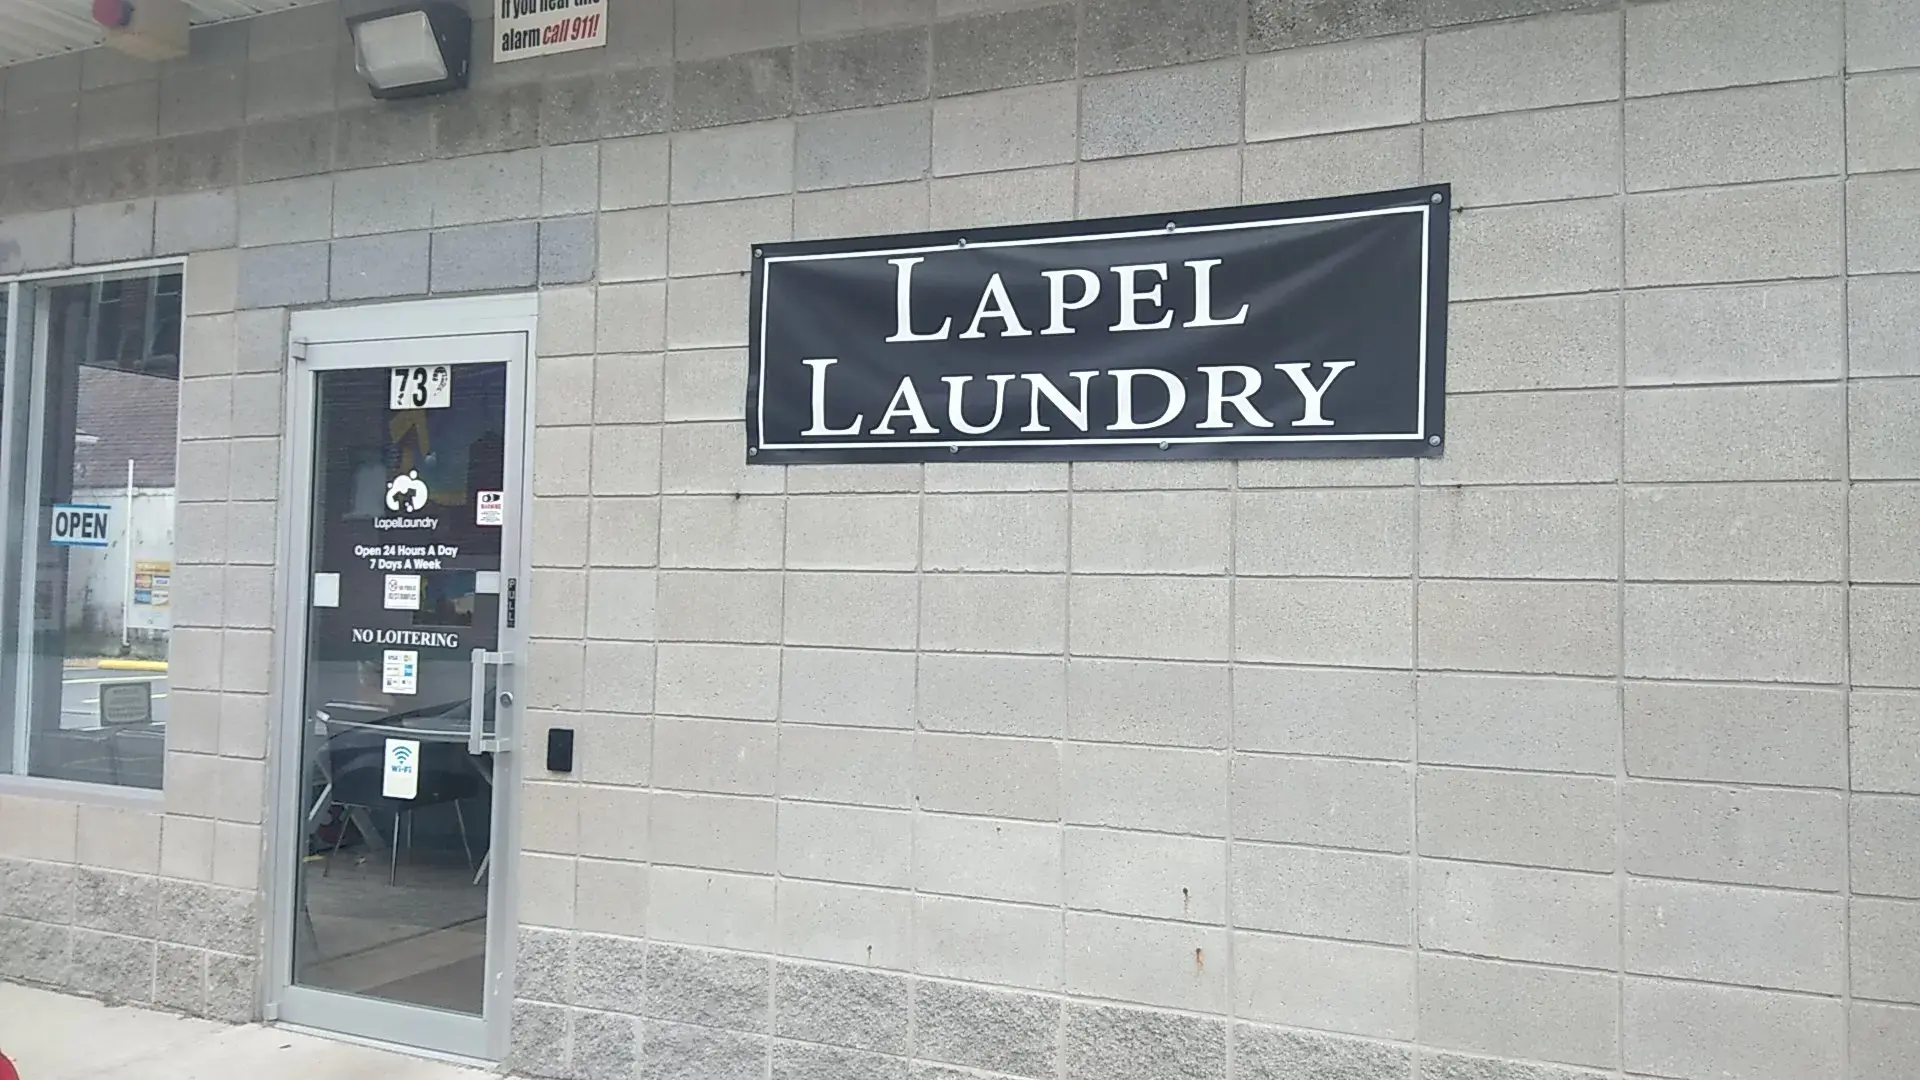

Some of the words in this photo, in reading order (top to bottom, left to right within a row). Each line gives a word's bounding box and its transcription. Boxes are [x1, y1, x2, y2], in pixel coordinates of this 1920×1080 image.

[512, 0, 537, 19] you
[502, 28, 541, 51] alarm
[542, 18, 571, 45] call
[571, 13, 600, 40] 911!
[885, 256, 1250, 342] LAPEL
[800, 358, 1356, 437] LAUNDRY
[55, 511, 108, 539] OPEN
[374, 517, 438, 530] LapelLaundry
[354, 545, 382, 558] Open
[383, 545, 396, 556] 24
[397, 545, 426, 556] Hours
[427, 545, 436, 556] A
[438, 545, 458, 558] Day
[369, 559, 377, 570] 7
[378, 559, 402, 571] Days
[404, 559, 412, 569] A
[413, 559, 441, 569] Week
[508, 579, 516, 621] PULL
[352, 629, 374, 643] NO
[376, 629, 458, 648] LOITERING
